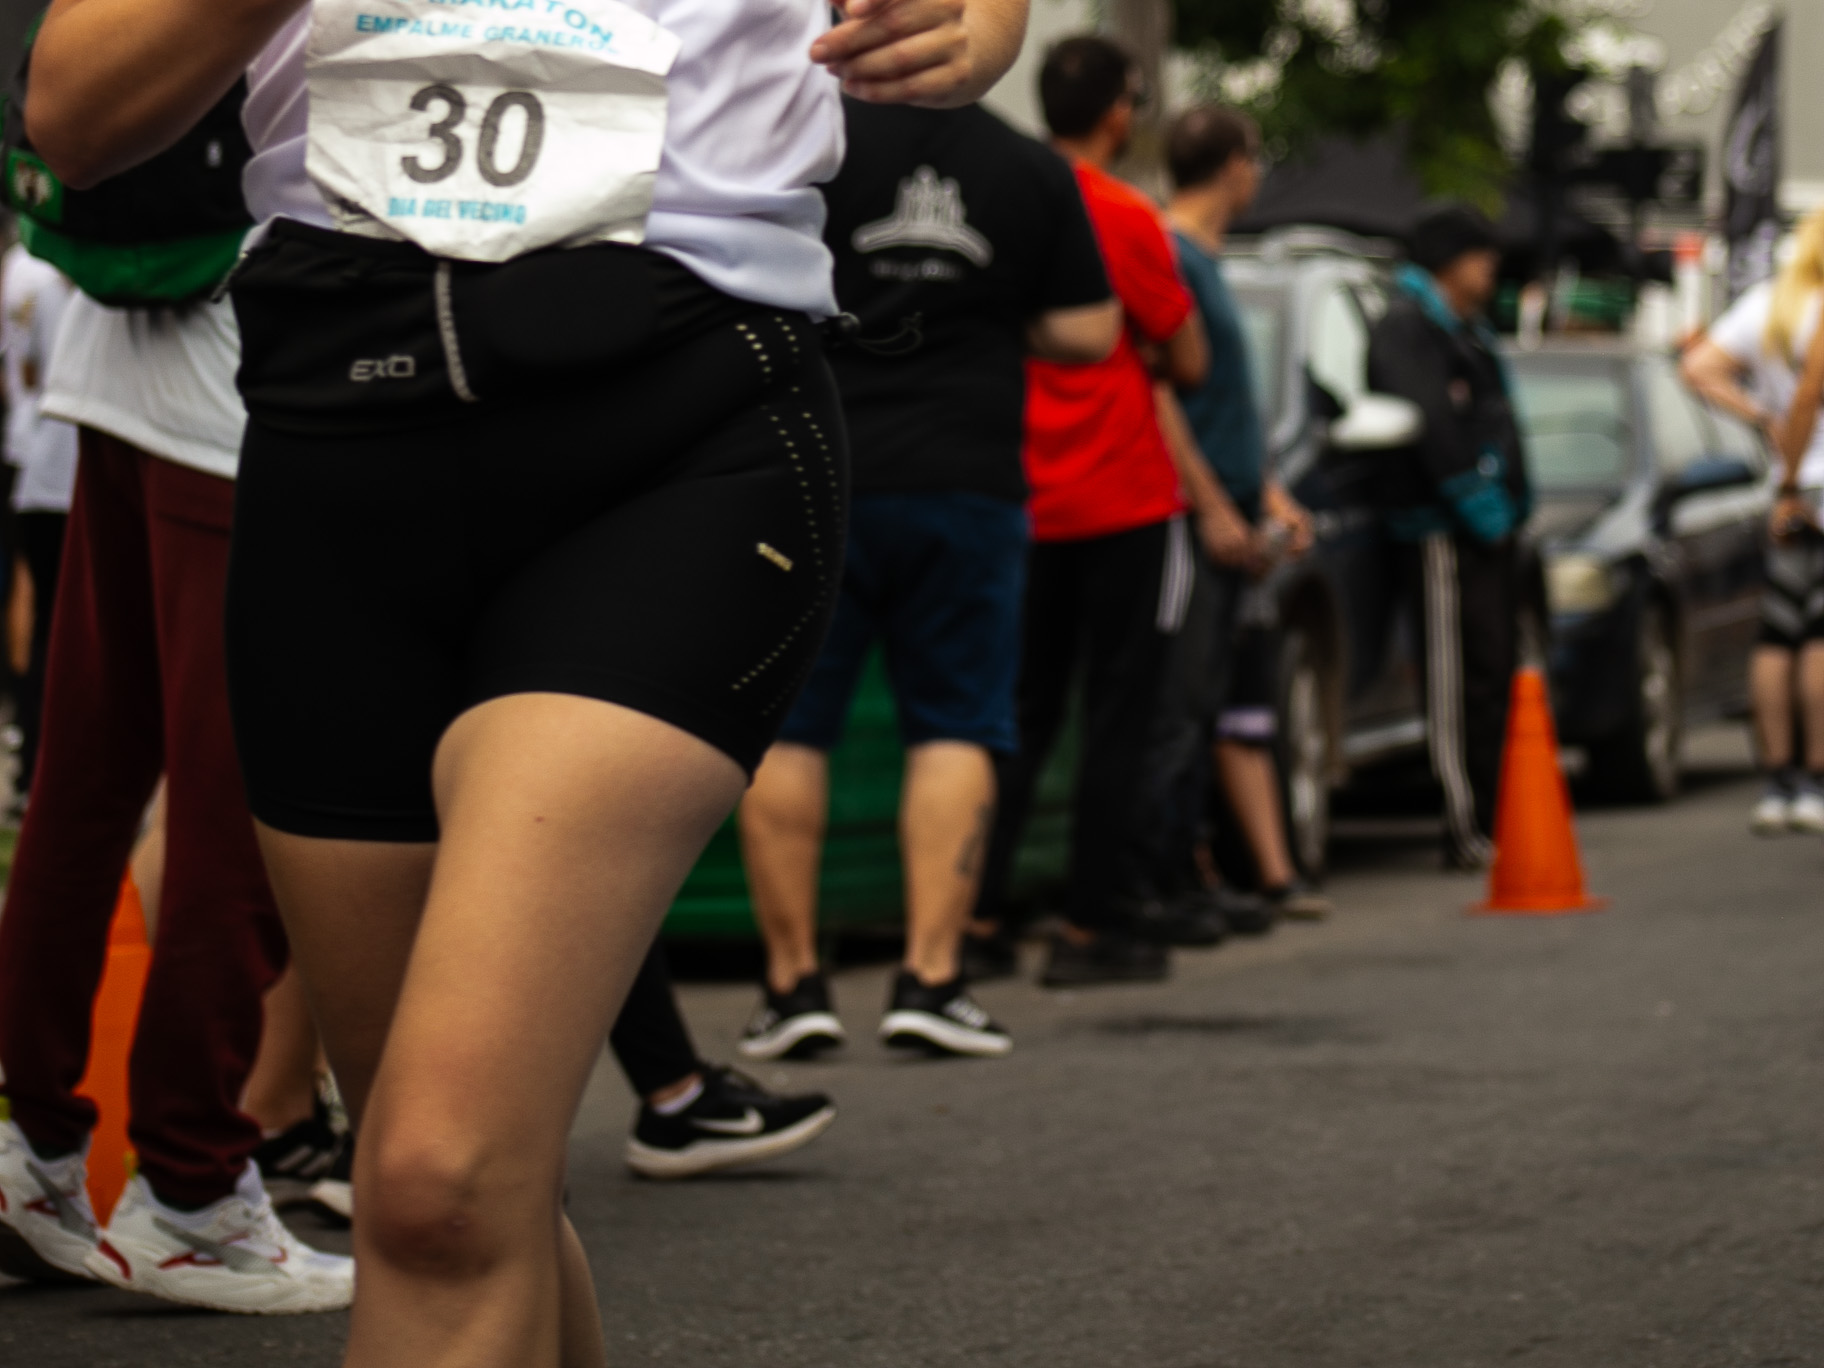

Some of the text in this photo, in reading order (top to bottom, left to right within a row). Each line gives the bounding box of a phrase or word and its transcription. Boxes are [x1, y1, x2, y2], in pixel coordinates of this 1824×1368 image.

[356, 14, 474, 39] EMPALME
[400, 83, 545, 187] 30
[350, 354, 416, 381] EXO
